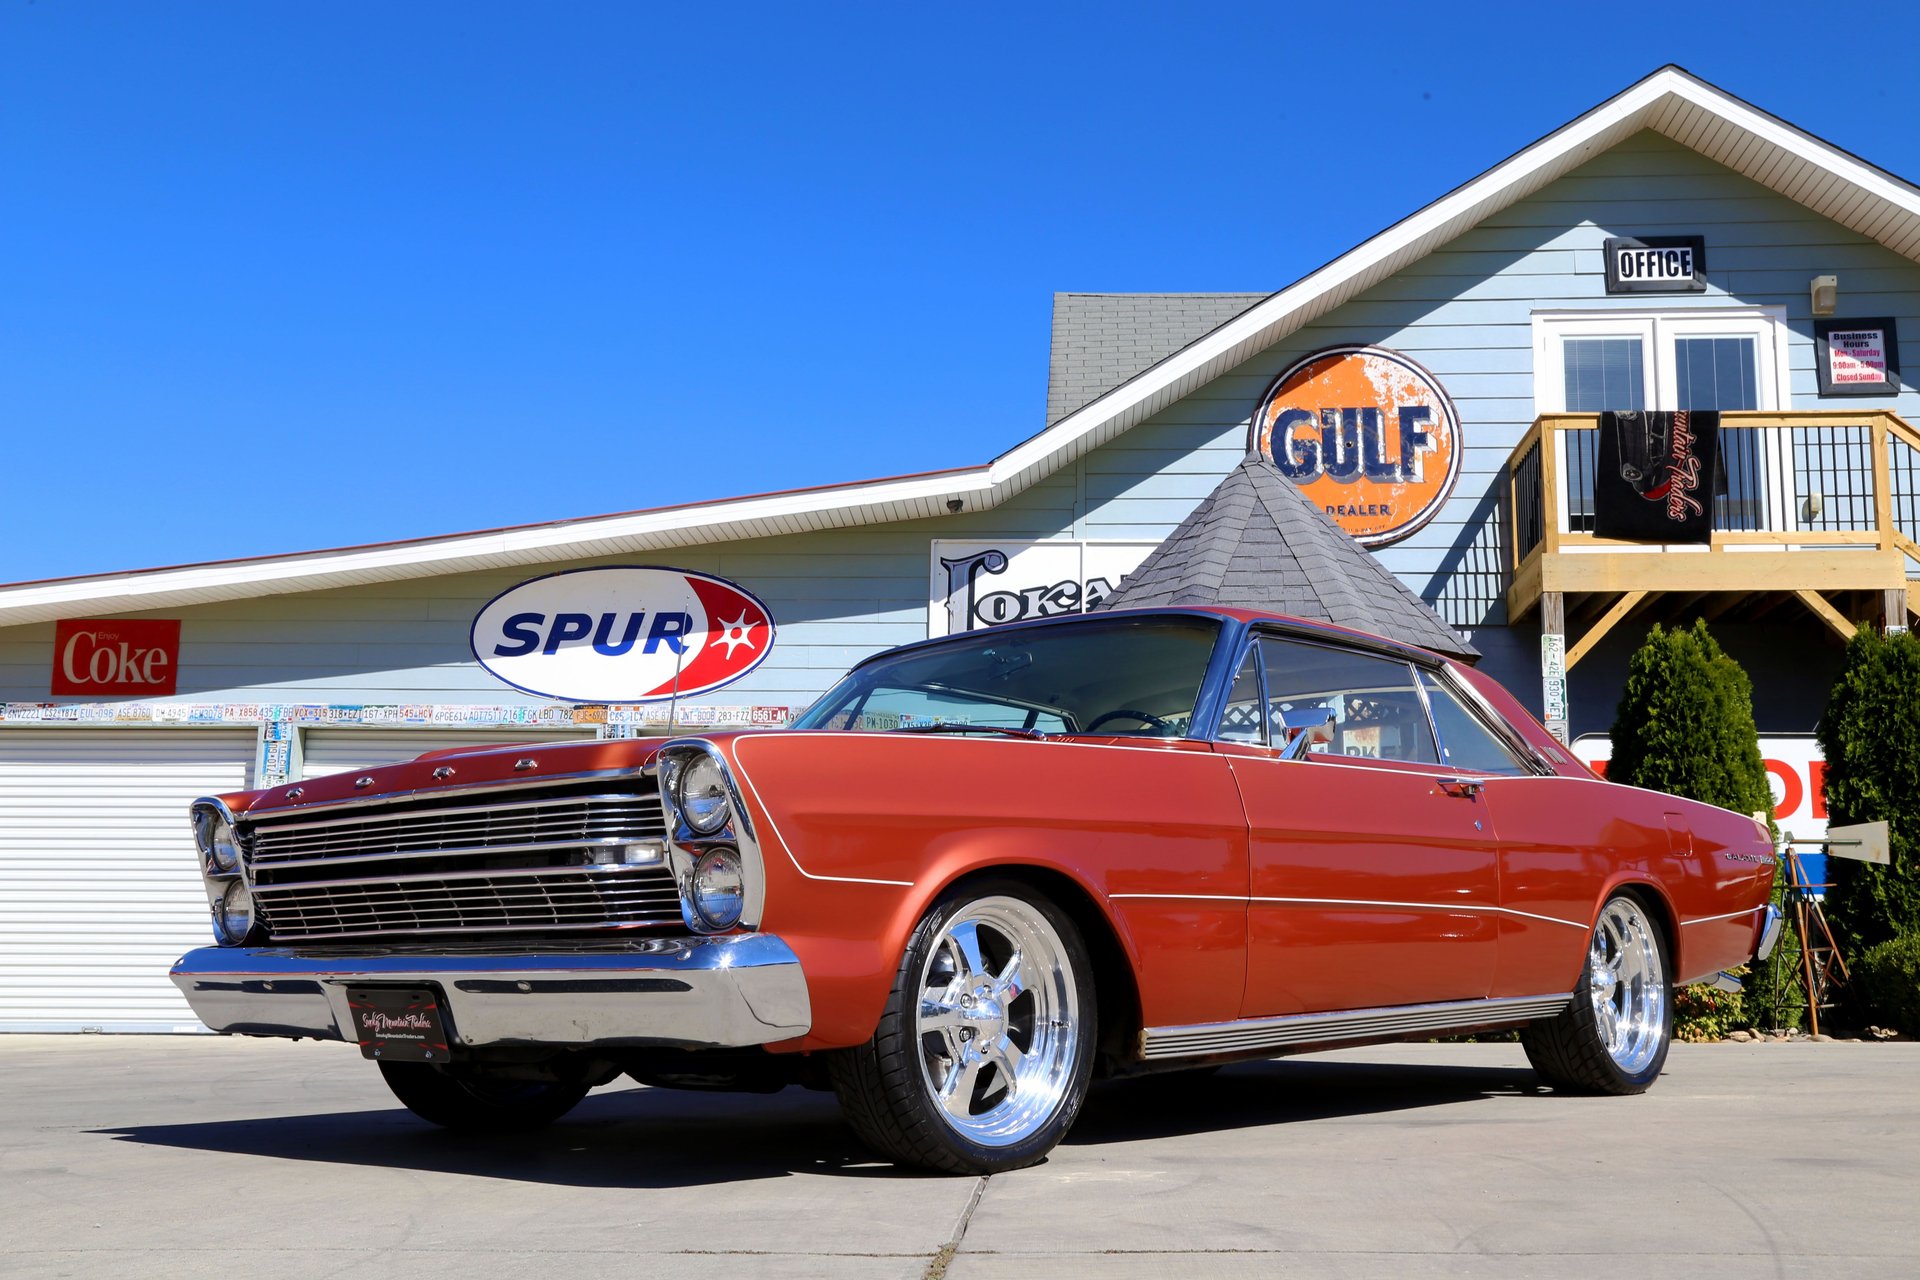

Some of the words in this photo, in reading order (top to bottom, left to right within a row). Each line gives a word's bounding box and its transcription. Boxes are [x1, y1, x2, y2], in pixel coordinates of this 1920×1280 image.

[1620, 250, 1692, 278] OFFICE
[1833, 332, 1878, 340] Business
[1834, 349, 1848, 357] Mon
[1852, 348, 1880, 357] Saturday
[1833, 361, 1856, 369] 9:00am
[1836, 373, 1858, 381] Closed
[1270, 405, 1439, 485] GULF
[1665, 456, 1702, 520] Traders
[1325, 504, 1391, 515] DEALER
[98, 631, 120, 641] Enjoy
[493, 612, 694, 657] SPUR
[62, 631, 168, 684] Coke
